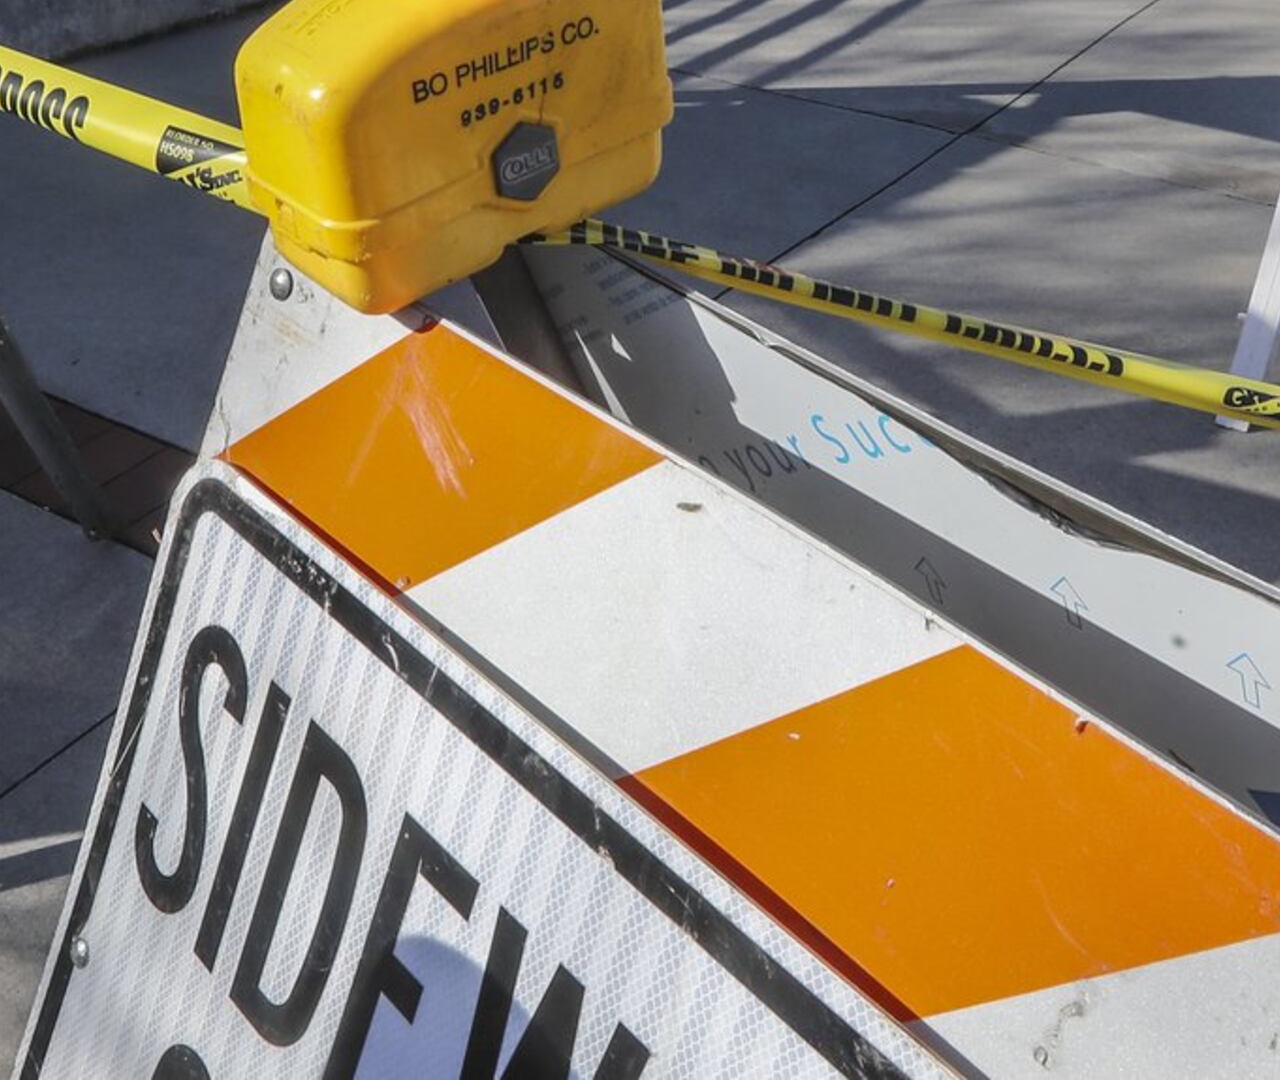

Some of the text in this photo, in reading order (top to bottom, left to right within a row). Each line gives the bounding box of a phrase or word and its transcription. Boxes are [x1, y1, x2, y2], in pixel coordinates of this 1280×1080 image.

[412, 17, 600, 103] BO PHILLIPS CO.
[460, 72, 564, 127] 939-6115
